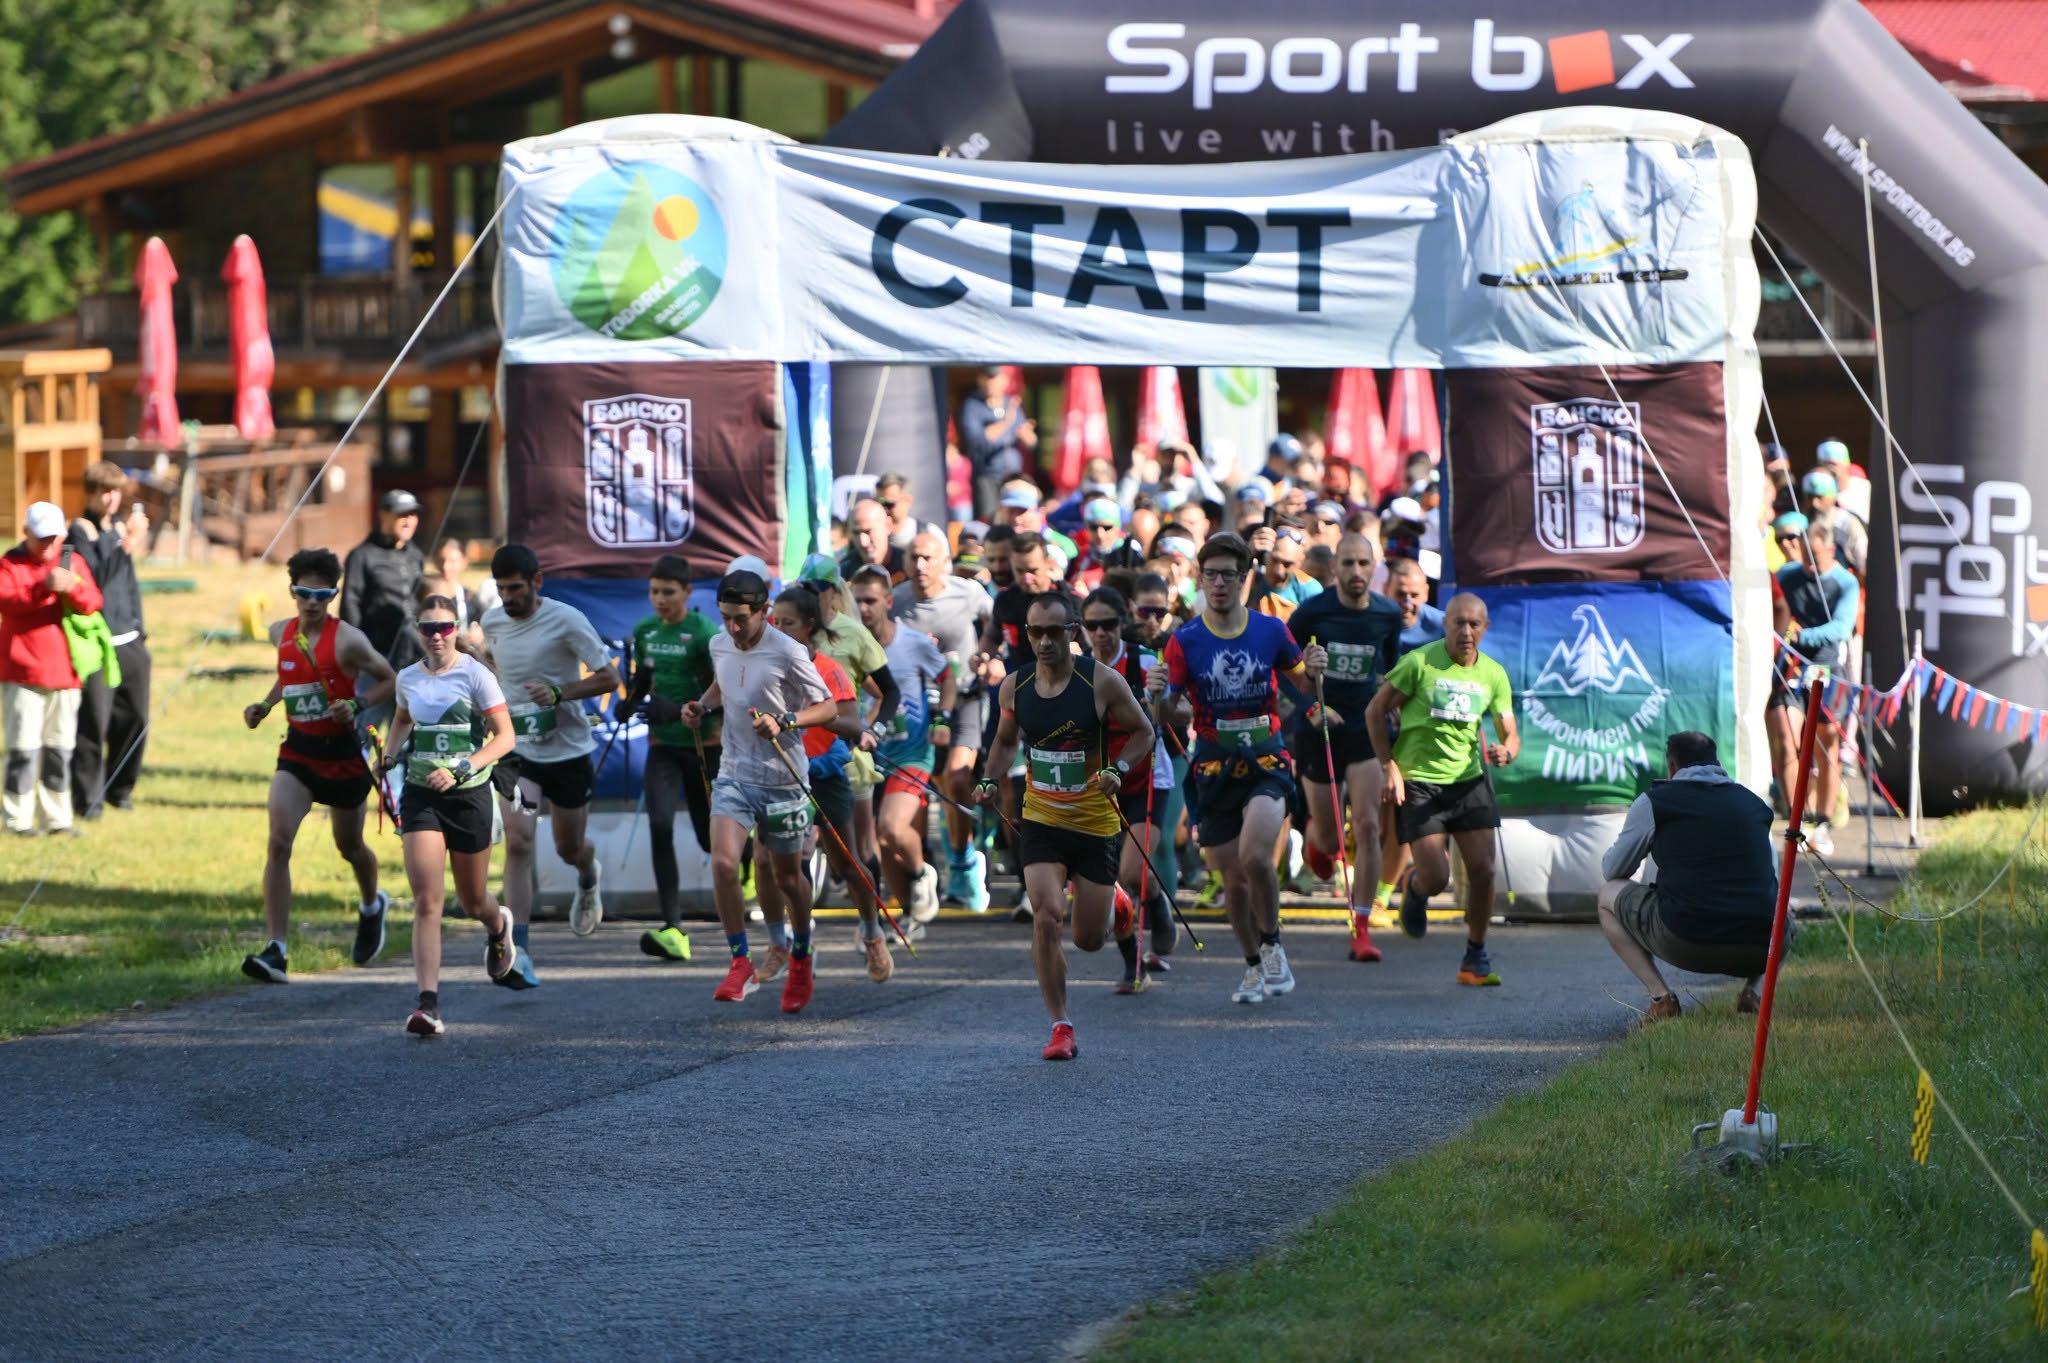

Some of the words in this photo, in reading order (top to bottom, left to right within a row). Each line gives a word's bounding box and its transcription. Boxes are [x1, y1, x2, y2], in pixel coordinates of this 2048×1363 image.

[1105, 22, 1439, 109] Sport
[1105, 119, 1222, 153] live
[1262, 119, 1396, 152] with
[871, 198, 1351, 312] СТАРТ
[592, 401, 683, 424] БАНСКО
[1540, 405, 1633, 427] БАНСКО
[1336, 655, 1362, 674] 95
[295, 695, 322, 713] 44
[1444, 692, 1471, 714] 29
[524, 716, 539, 734] 2
[435, 733, 449, 751] 6
[1237, 731, 1252, 747] 3
[1050, 765, 1061, 784] 1
[782, 809, 808, 830] 10
